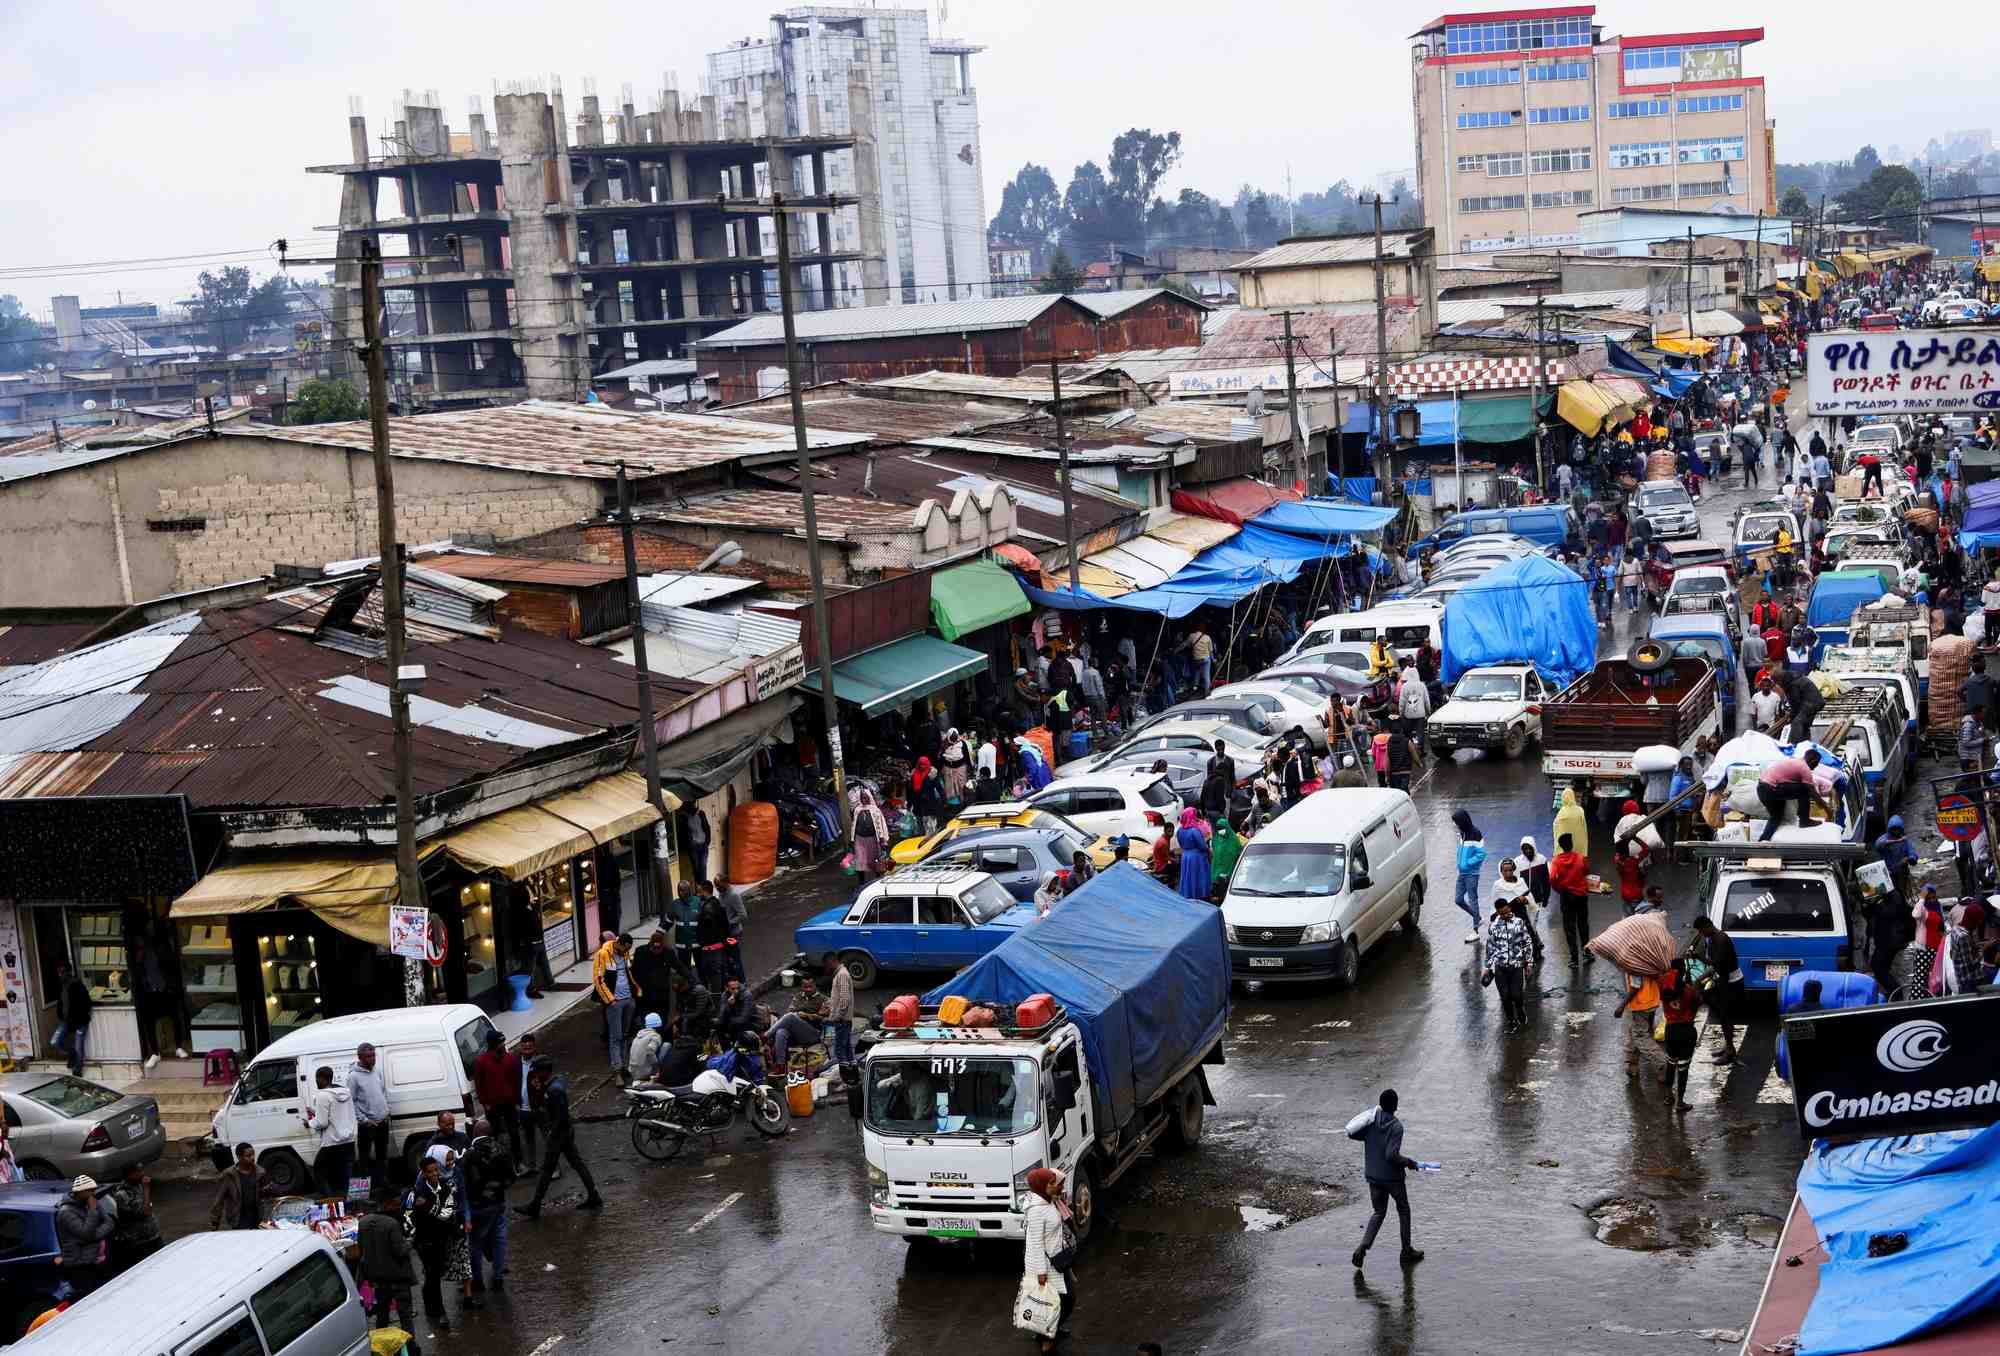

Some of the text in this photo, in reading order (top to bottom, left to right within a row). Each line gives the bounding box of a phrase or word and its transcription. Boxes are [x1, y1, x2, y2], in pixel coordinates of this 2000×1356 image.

[1823, 340, 1870, 371] ዋስ
[1959, 371, 1994, 390] ቤት
[1564, 760, 1601, 768] ISUZU
[930, 1172, 967, 1180] ISUZU
